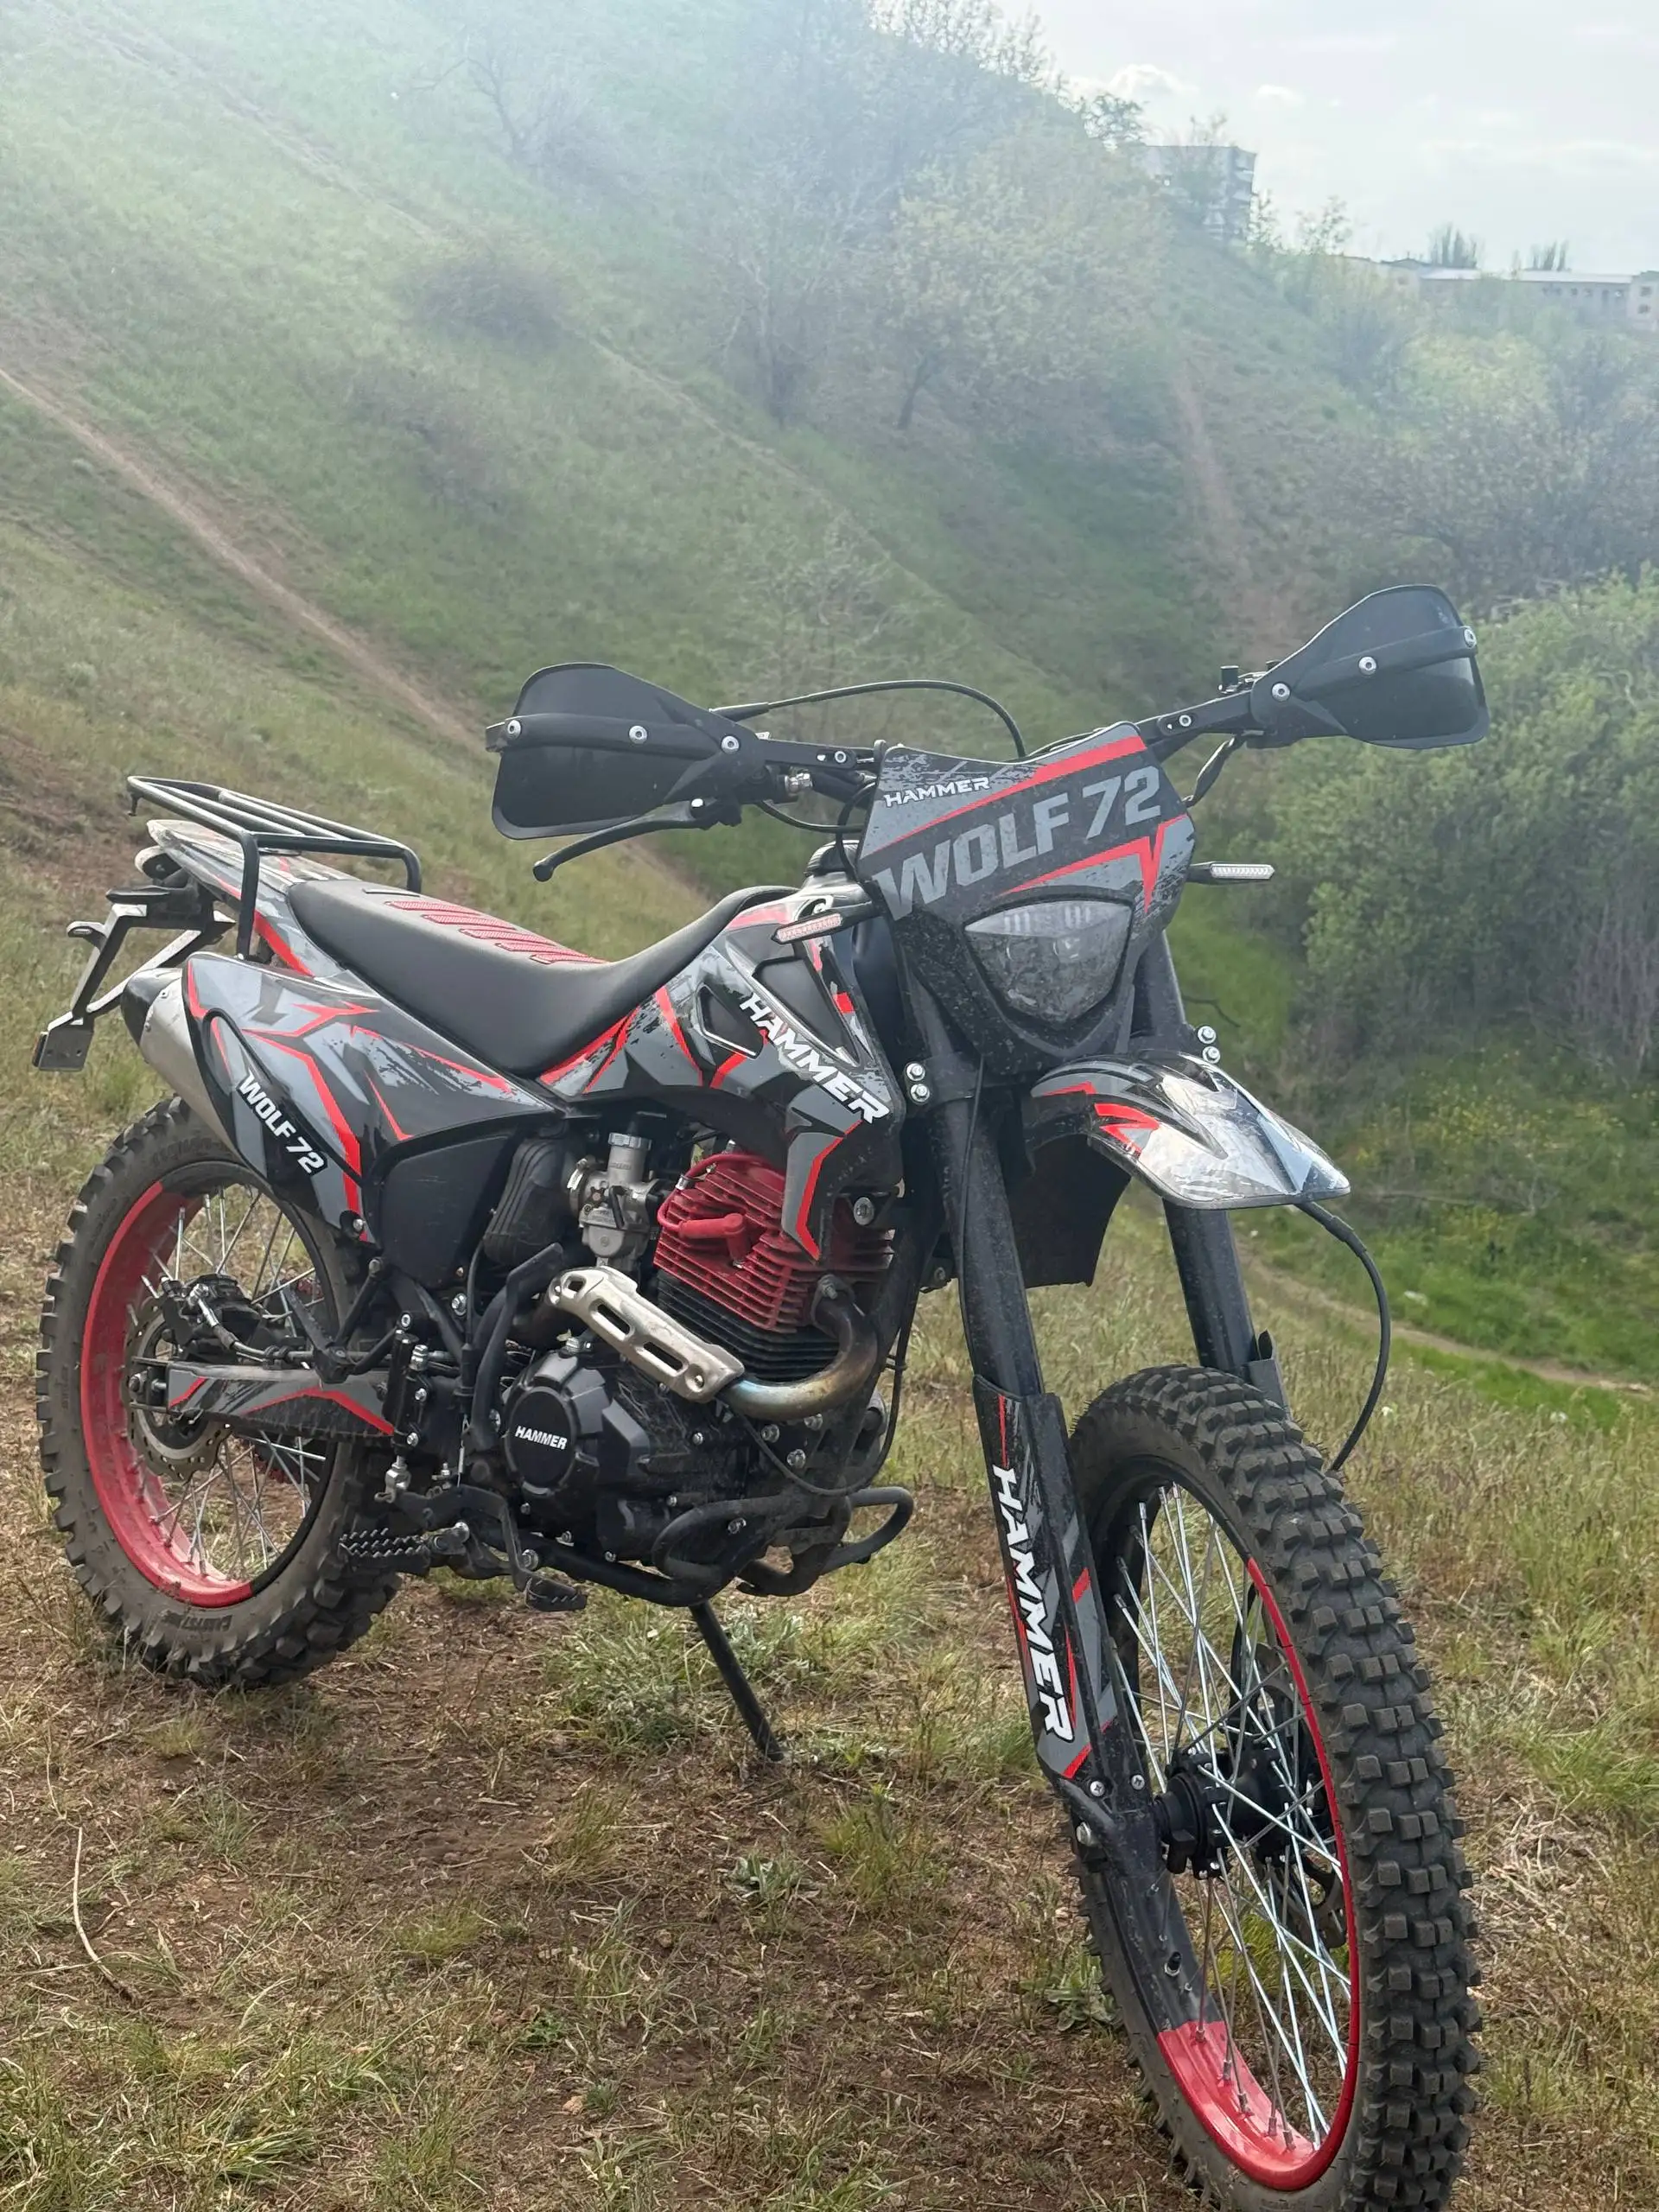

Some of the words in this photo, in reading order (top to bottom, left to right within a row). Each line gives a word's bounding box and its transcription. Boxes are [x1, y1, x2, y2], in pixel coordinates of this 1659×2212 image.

[872, 791, 1070, 921] WOLF
[1082, 766, 1161, 840] 72
[884, 777, 990, 807] HAMMER
[739, 993, 890, 1124] HAMMER
[238, 1075, 297, 1138] WOLF
[285, 1136, 325, 1173] 72
[515, 1426, 567, 1450] HAMMER
[992, 1465, 1074, 1742] HAMMER
